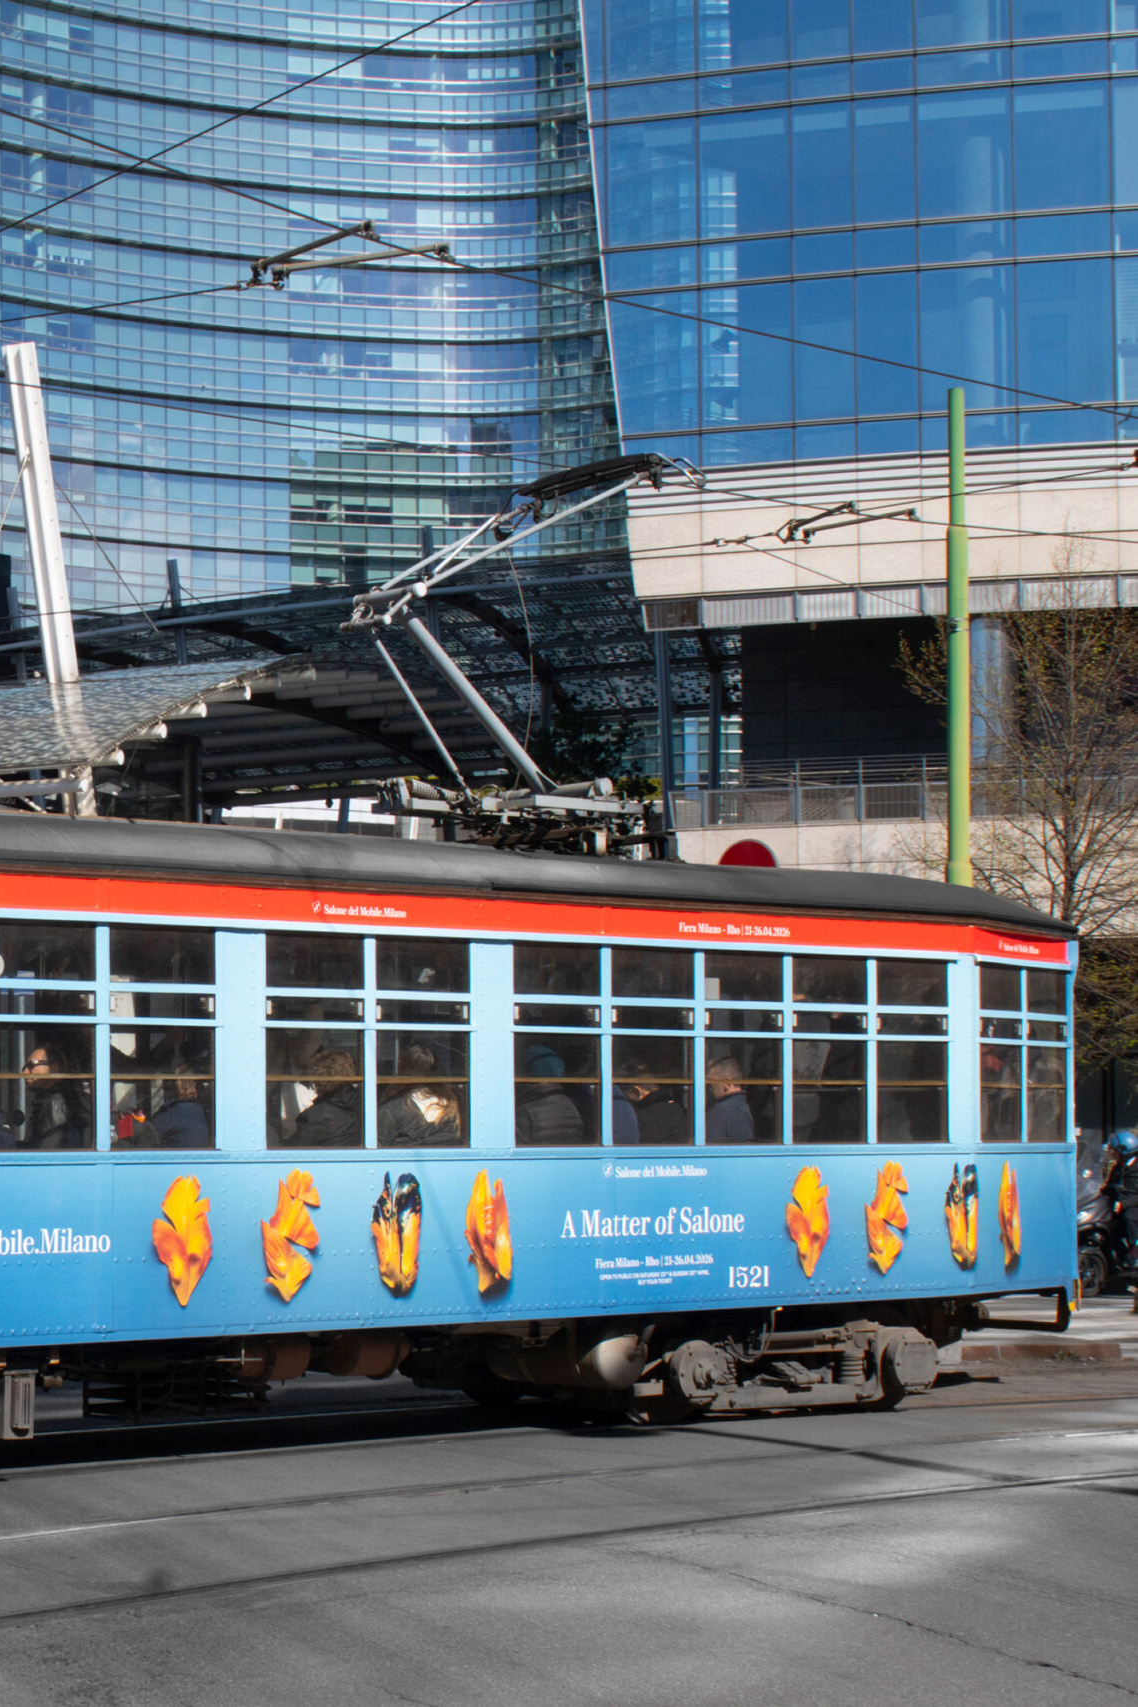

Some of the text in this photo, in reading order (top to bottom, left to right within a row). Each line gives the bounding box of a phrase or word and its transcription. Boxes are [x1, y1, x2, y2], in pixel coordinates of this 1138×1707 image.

[324, 904, 347, 915] Salone
[348, 905, 359, 916] del
[679, 922, 697, 933] Fiera
[698, 923, 721, 934] Milano
[727, 924, 740, 935] Rho
[615, 1166, 641, 1178] Salone
[642, 1166, 655, 1178] del
[560, 1206, 745, 1238] A Matter of Salone
[595, 1257, 615, 1269] Fiera
[615, 1256, 640, 1268] Milano
[645, 1255, 660, 1267] Rho
[728, 1265, 769, 1288] 1521
